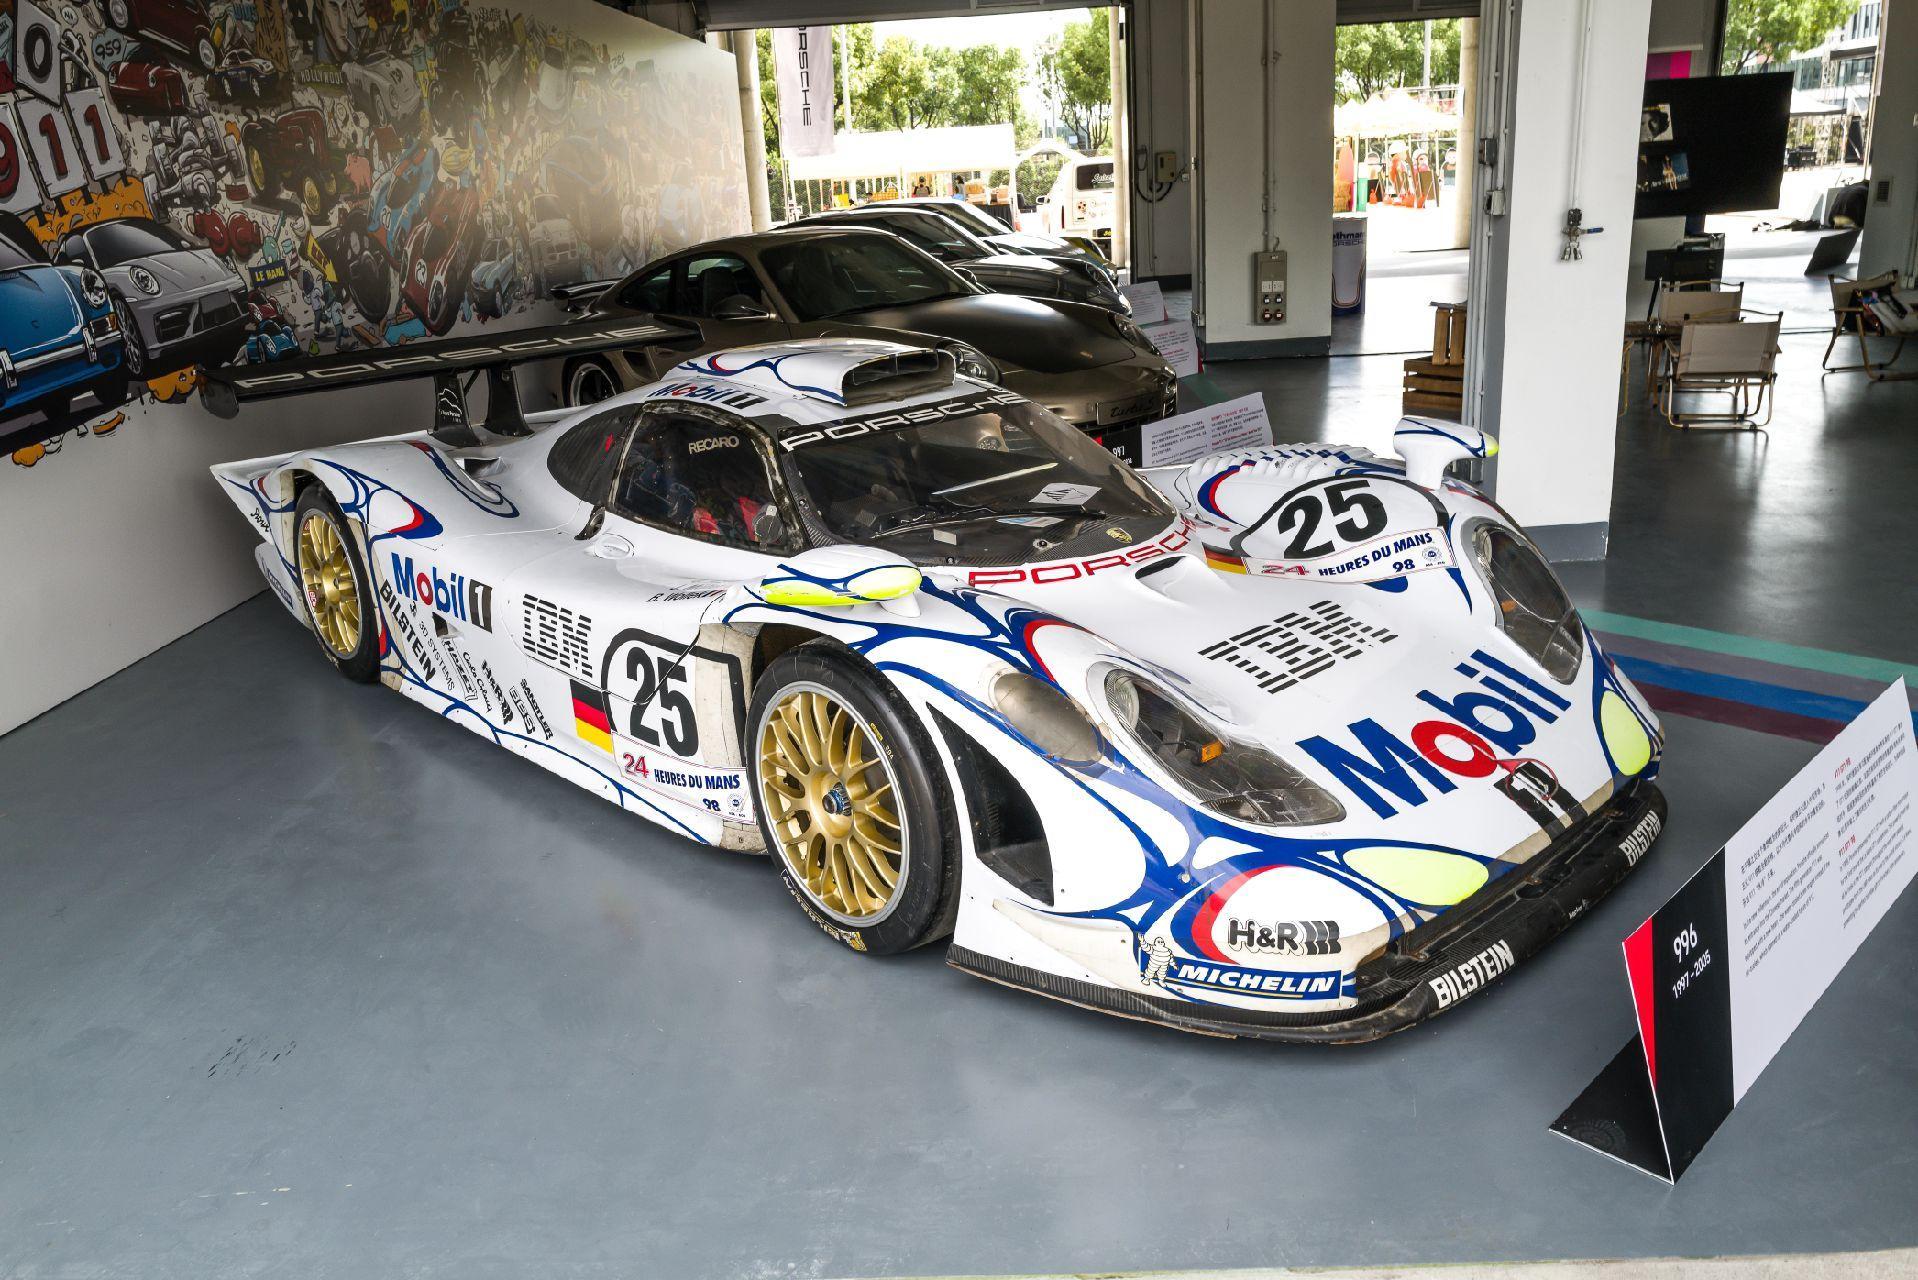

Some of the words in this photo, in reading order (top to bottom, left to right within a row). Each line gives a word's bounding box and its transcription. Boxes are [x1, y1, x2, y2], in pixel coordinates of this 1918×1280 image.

[234, 324, 667, 388] PORSCHE
[648, 382, 741, 401] Mobil
[688, 436, 740, 455] RECARO
[780, 391, 1031, 452] PORSCHE
[1112, 445, 1125, 458] 997
[1278, 480, 1388, 559] 25
[1262, 565, 1309, 576] 24
[1318, 556, 1370, 577] HEURES
[1371, 545, 1392, 562] DU
[1394, 532, 1433, 555] MANS
[1392, 558, 1416, 573] 98
[391, 552, 467, 622] Mobil
[380, 579, 436, 682] BILSTEIN
[522, 593, 594, 678] IBM
[1197, 600, 1399, 695] IBM
[427, 637, 456, 691] SYSTEMS
[626, 647, 699, 757] 25
[1294, 649, 1572, 821] Mobil
[623, 753, 650, 779] 24
[654, 768, 687, 788] HEURES
[688, 775, 703, 789] DU
[704, 774, 741, 790] MANS
[702, 797, 722, 812] 98
[1618, 810, 1662, 867] BILSTEIN
[1228, 918, 1304, 956] H&R
[1673, 922, 1698, 963] 996
[1177, 964, 1336, 993] MICHELIN
[1428, 939, 1515, 1010] BILSTEIN
[1672, 970, 1689, 999] 1997
[1693, 949, 1711, 978] 2005
